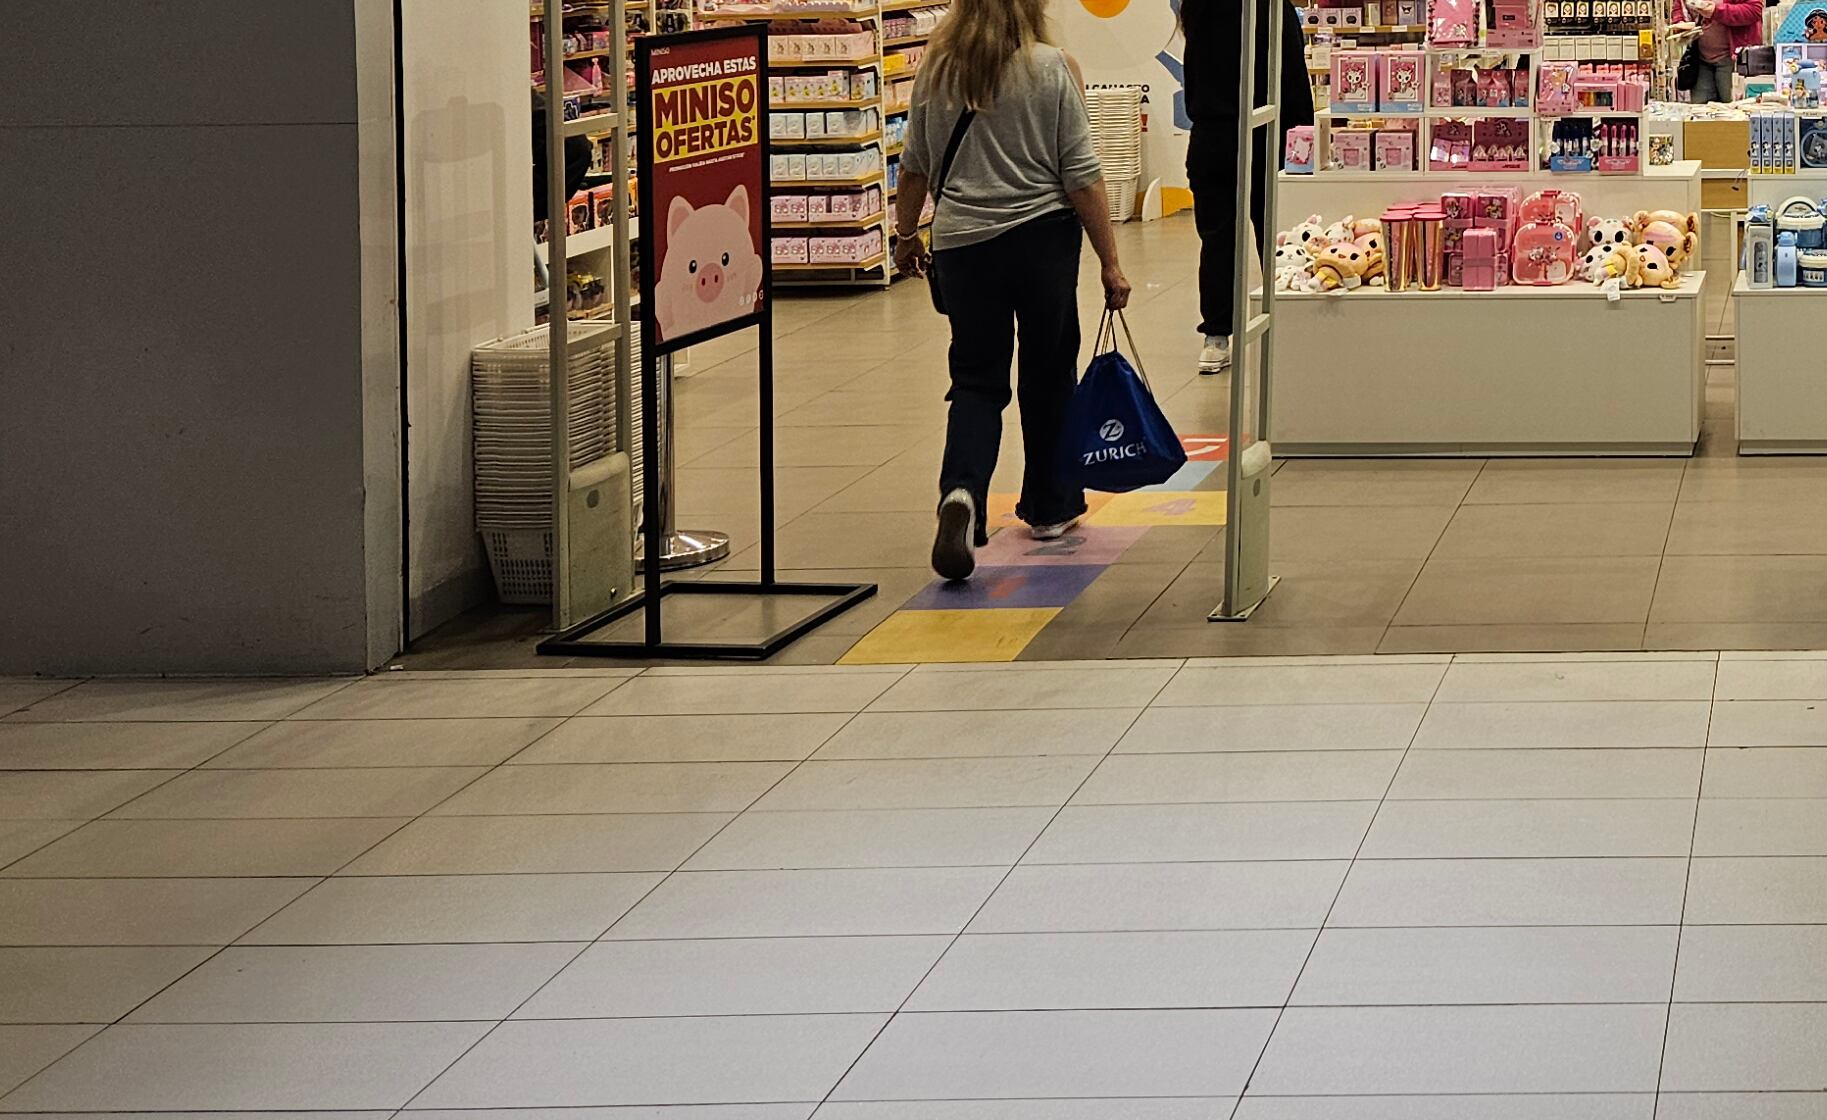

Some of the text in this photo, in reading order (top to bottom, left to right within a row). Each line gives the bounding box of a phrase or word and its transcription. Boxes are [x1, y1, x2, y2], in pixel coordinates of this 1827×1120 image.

[651, 55, 757, 85] APROVECHA ESTAS
[654, 78, 756, 130] MINISO
[1083, 442, 1148, 466] ZURICH
